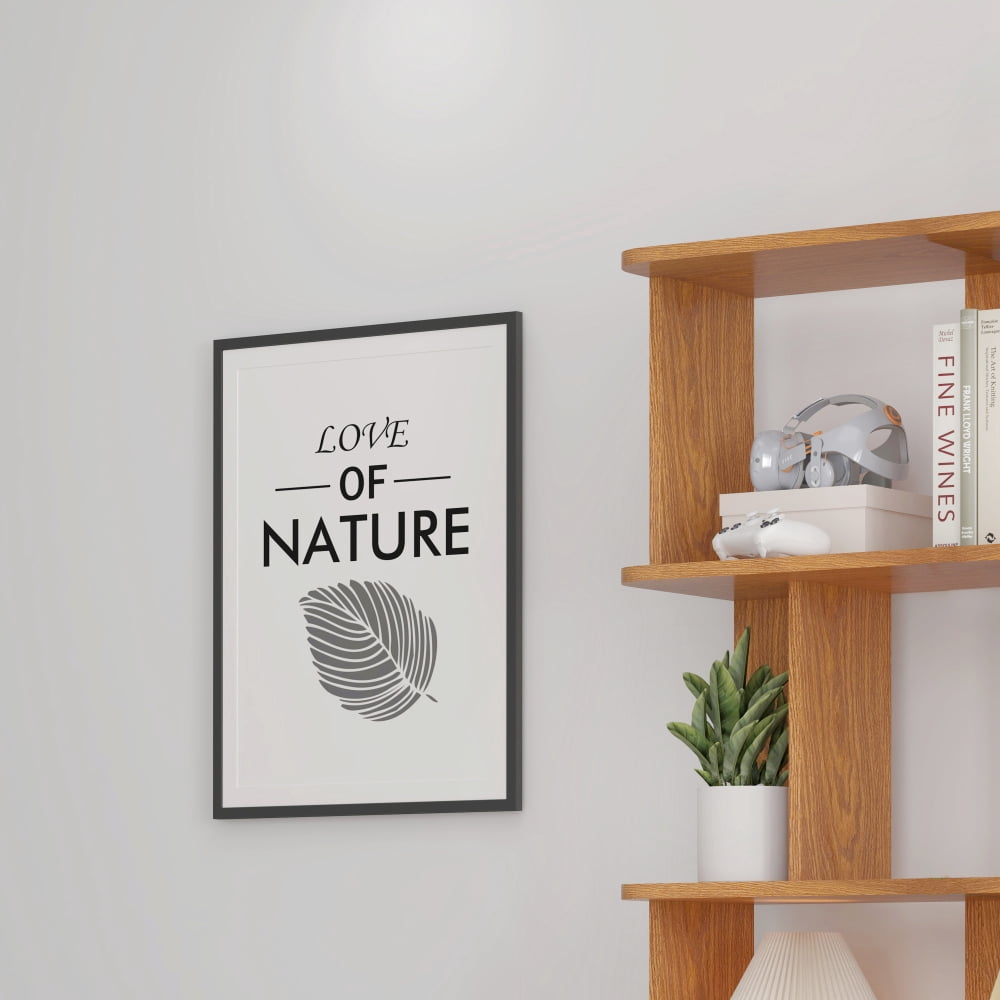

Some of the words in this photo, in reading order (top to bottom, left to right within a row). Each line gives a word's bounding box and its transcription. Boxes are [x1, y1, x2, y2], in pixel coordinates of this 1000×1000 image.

[937, 355, 955, 417] FINE
[990, 372, 997, 380] of
[962, 385, 971, 411] FRANK
[315, 416, 410, 454] LOVE
[962, 413, 971, 439] LLOYD
[937, 429, 955, 522] WINES
[962, 441, 971, 474] WRIGHT
[339, 464, 388, 501] OF
[263, 506, 470, 568] NATURE
